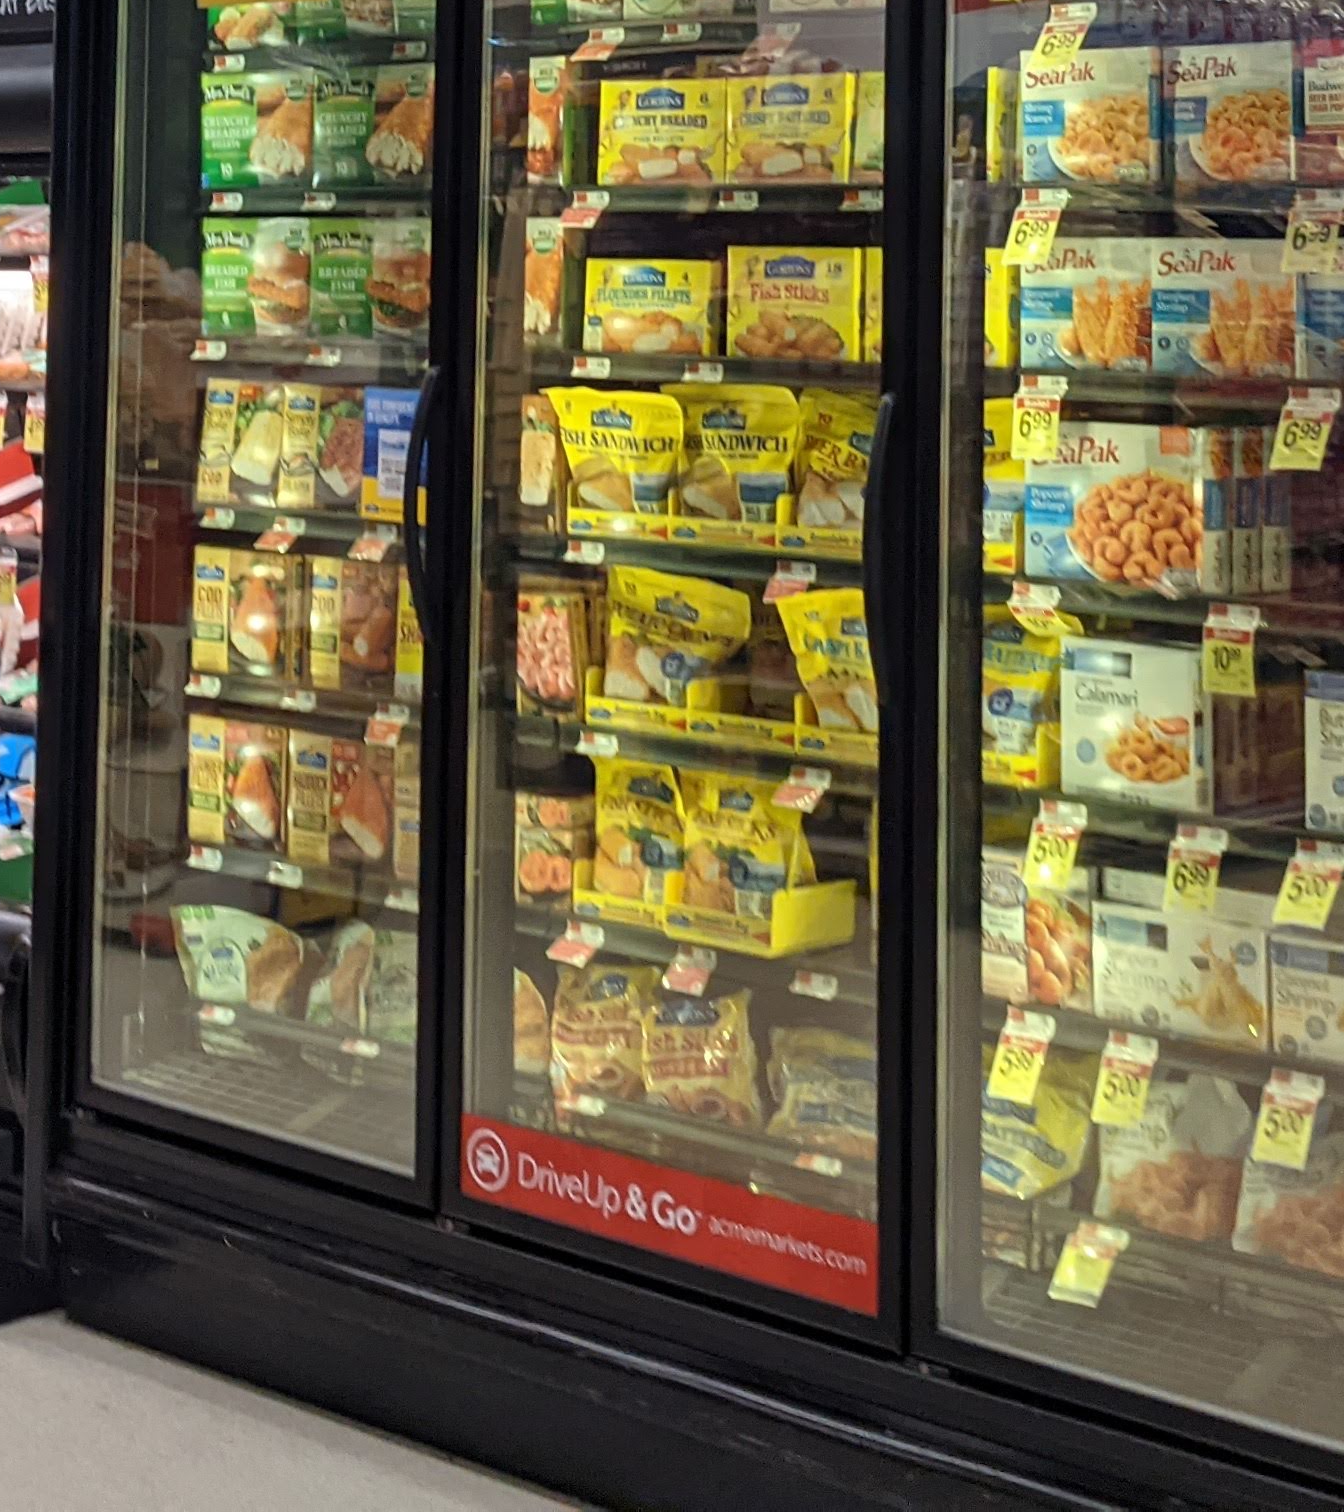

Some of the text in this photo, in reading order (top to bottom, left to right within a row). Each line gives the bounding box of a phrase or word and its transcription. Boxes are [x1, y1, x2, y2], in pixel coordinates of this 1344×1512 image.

[1041, 30, 1078, 57] 699
[1166, 54, 1238, 87] SeaPak
[318, 111, 368, 124] CRUNCHY
[1014, 221, 1050, 247] 699
[1025, 248, 1097, 273] aPak
[1158, 248, 1236, 276] SeaPak
[749, 283, 830, 304] Fish Sticks
[1019, 410, 1053, 438] 699
[1283, 421, 1323, 449] 699
[589, 429, 675, 453] SANDWICH
[1030, 437, 1121, 467] eaPak
[1075, 680, 1138, 707] Calamari
[516, 1153, 867, 1276] DriveUp & Go acmemarkets.com
